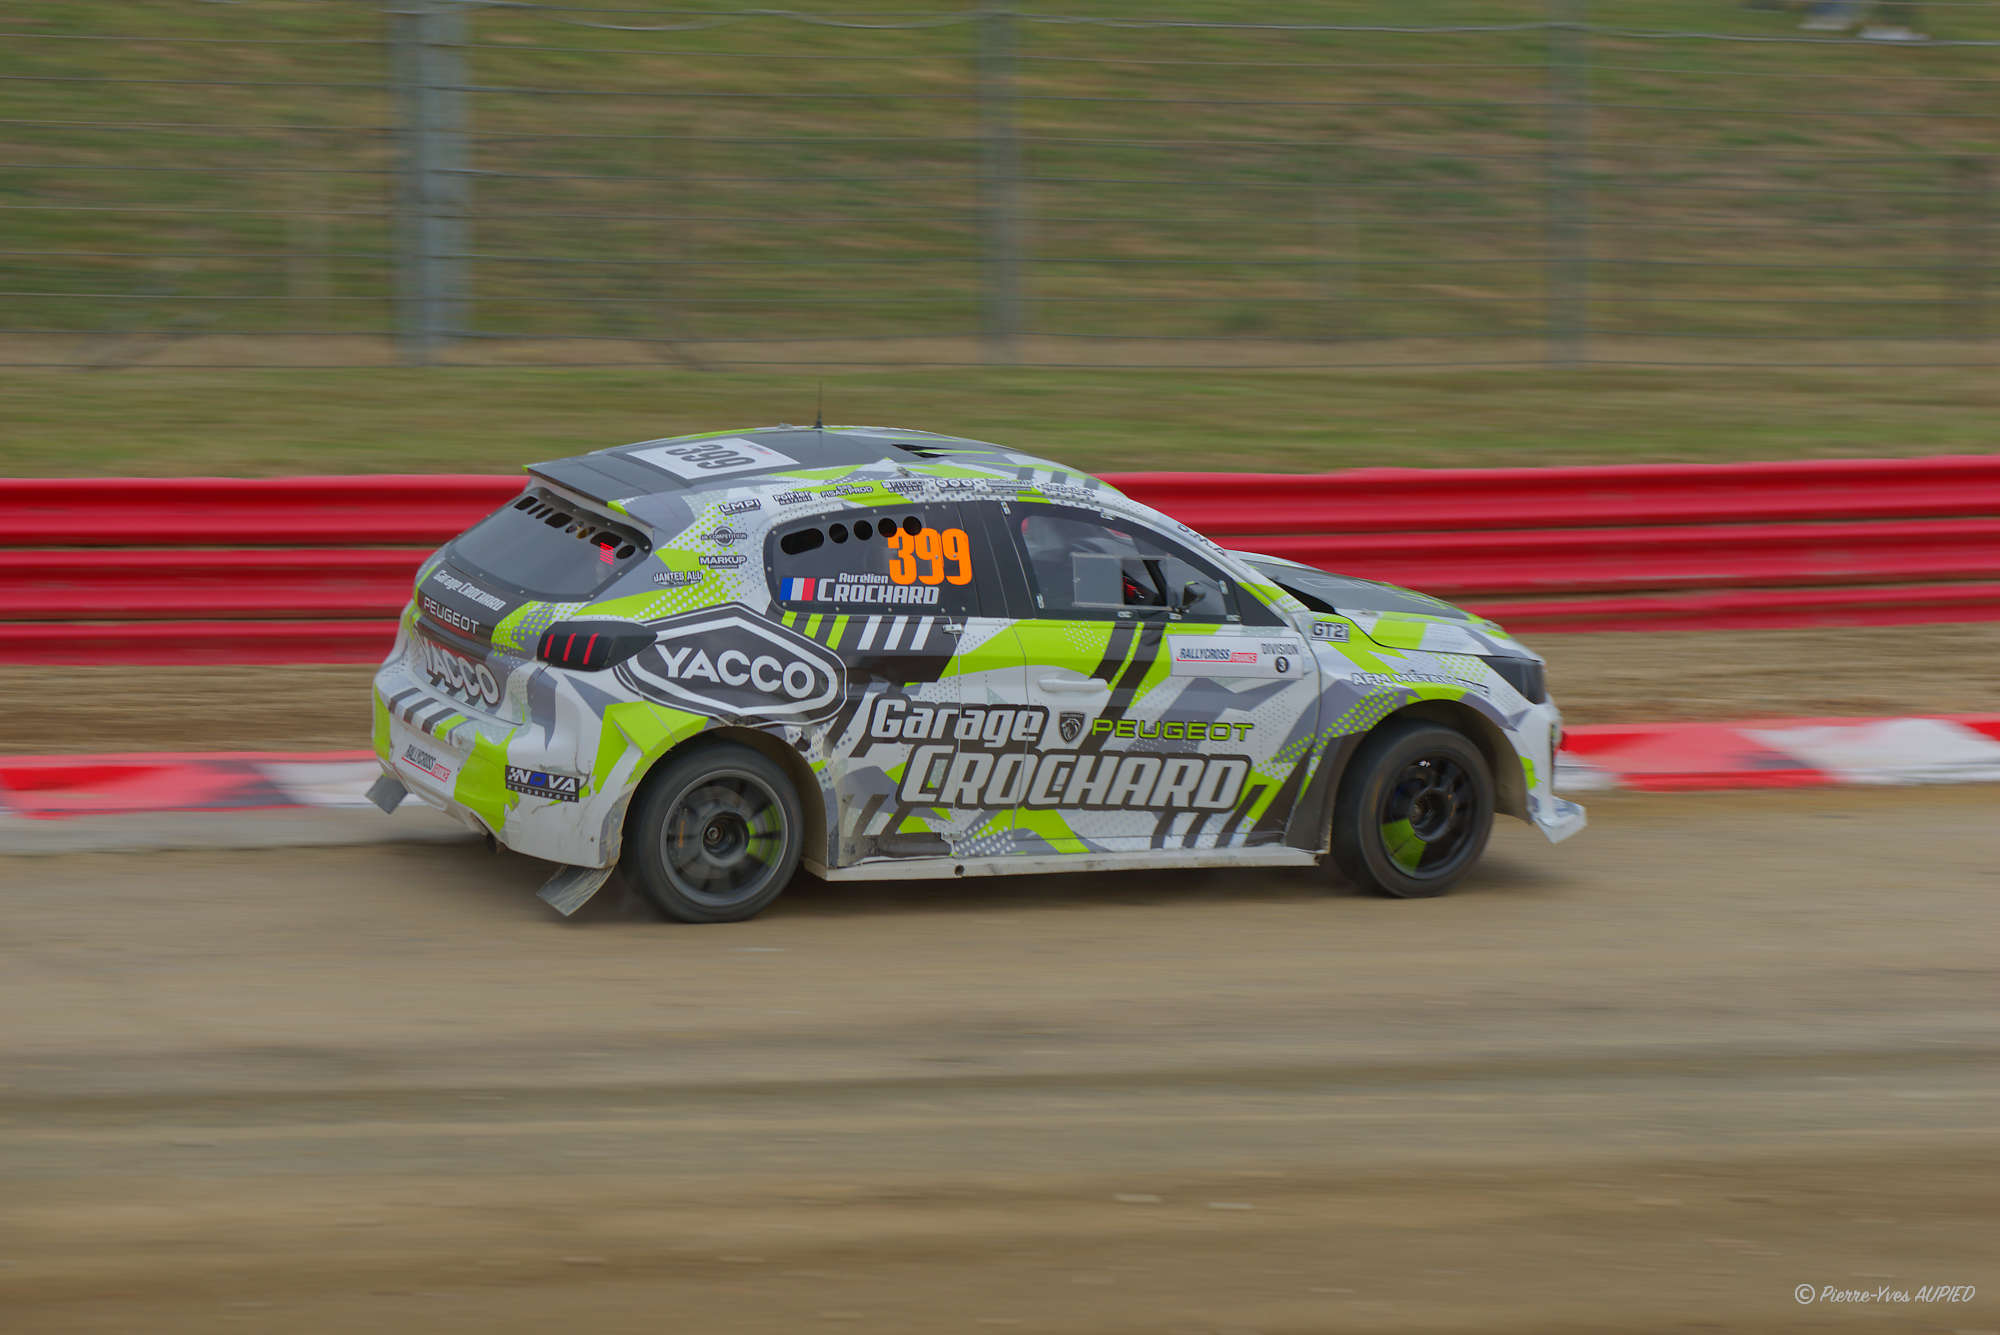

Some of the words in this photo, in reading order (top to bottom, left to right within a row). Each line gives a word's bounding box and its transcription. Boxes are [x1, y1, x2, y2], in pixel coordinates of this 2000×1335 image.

[665, 444, 756, 470] 399
[720, 499, 761, 513] LMPI
[699, 555, 747, 565] MARKUP
[888, 527, 973, 586] 399
[653, 571, 684, 583] JANTES
[838, 573, 889, 584] Aurélien
[816, 578, 940, 605] CROCHARD
[423, 596, 480, 635] PEUGEOT
[1179, 648, 1231, 660] RALLYCROSS
[1261, 643, 1299, 655] DIVISION
[415, 628, 500, 705] YACCO
[655, 644, 815, 699] YACCO
[870, 698, 1047, 747] Garage
[1091, 718, 1254, 742] PEUGEOT
[406, 744, 436, 771] RALLYCROSS
[508, 767, 576, 792] NOVA
[901, 745, 1248, 809] CROCHARD
